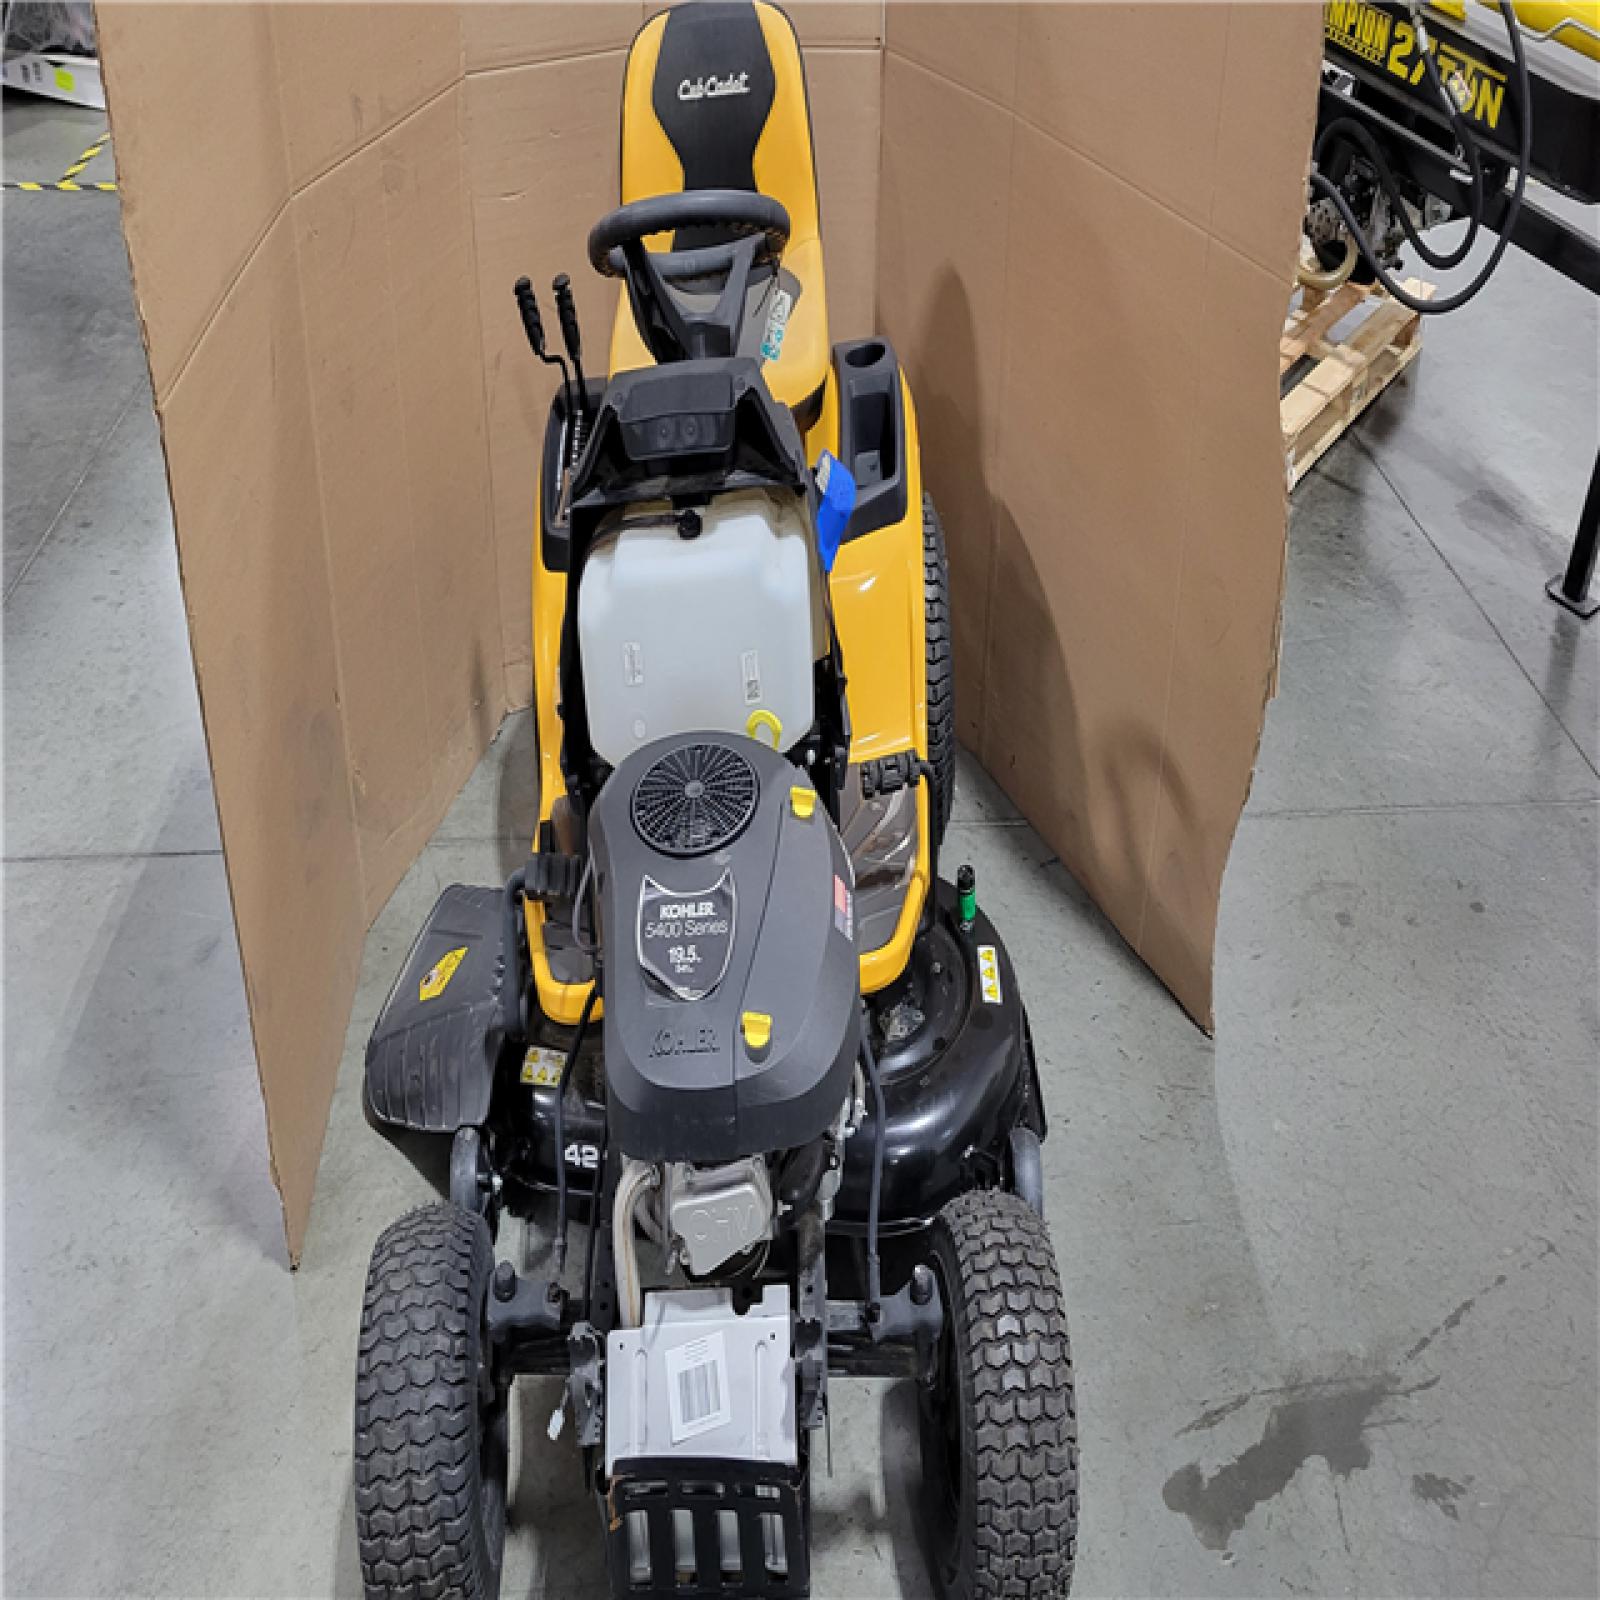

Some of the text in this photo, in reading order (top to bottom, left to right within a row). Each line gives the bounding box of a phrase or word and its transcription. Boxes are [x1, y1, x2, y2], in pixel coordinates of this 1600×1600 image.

[659, 901, 715, 920] KOHLER
[644, 918, 728, 939] 5400 Series
[564, 1143, 599, 1169] 42
